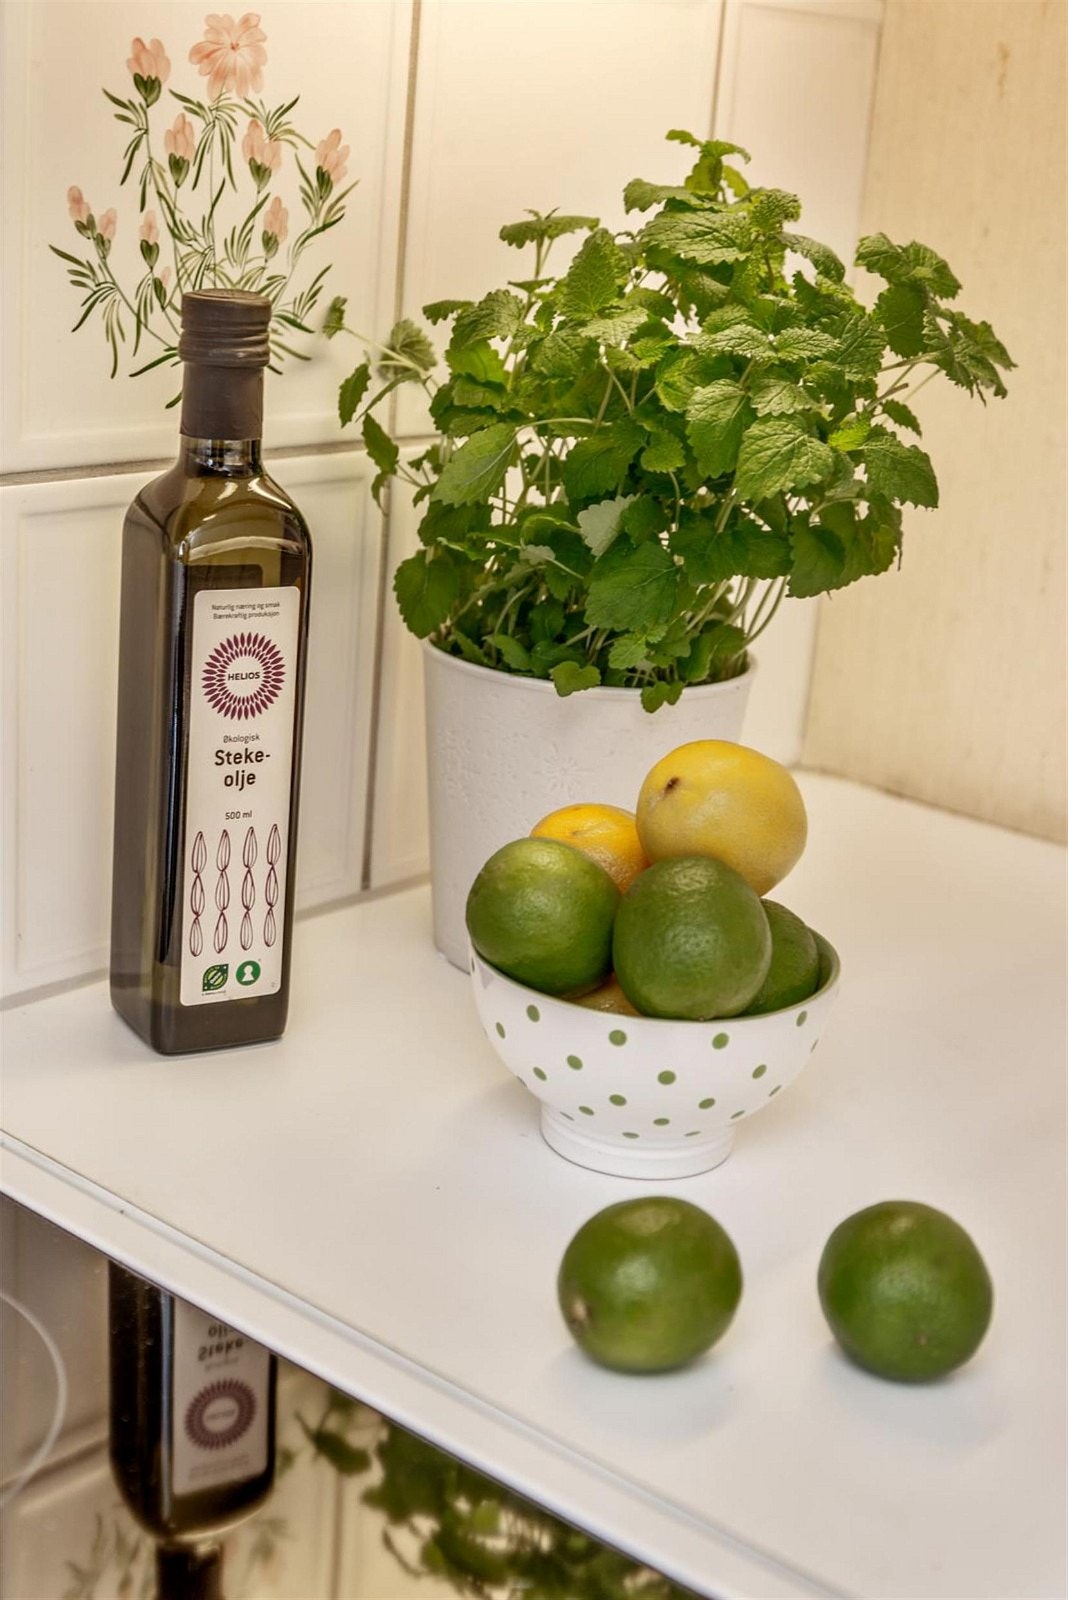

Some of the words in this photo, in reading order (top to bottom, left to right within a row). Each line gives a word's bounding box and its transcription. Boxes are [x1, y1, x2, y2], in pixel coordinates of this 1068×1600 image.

[211, 603, 235, 612] Naturlig
[236, 603, 256, 611] næring
[265, 601, 280, 609] smak
[213, 612, 248, 620] Bærekraftig
[248, 611, 280, 619] produksjon
[227, 671, 261, 681] HELIOS
[223, 733, 261, 744] Økologisk
[214, 747, 271, 766] Steke-
[224, 769, 256, 792] olje
[225, 810, 241, 820] 500
[242, 810, 253, 819] ml
